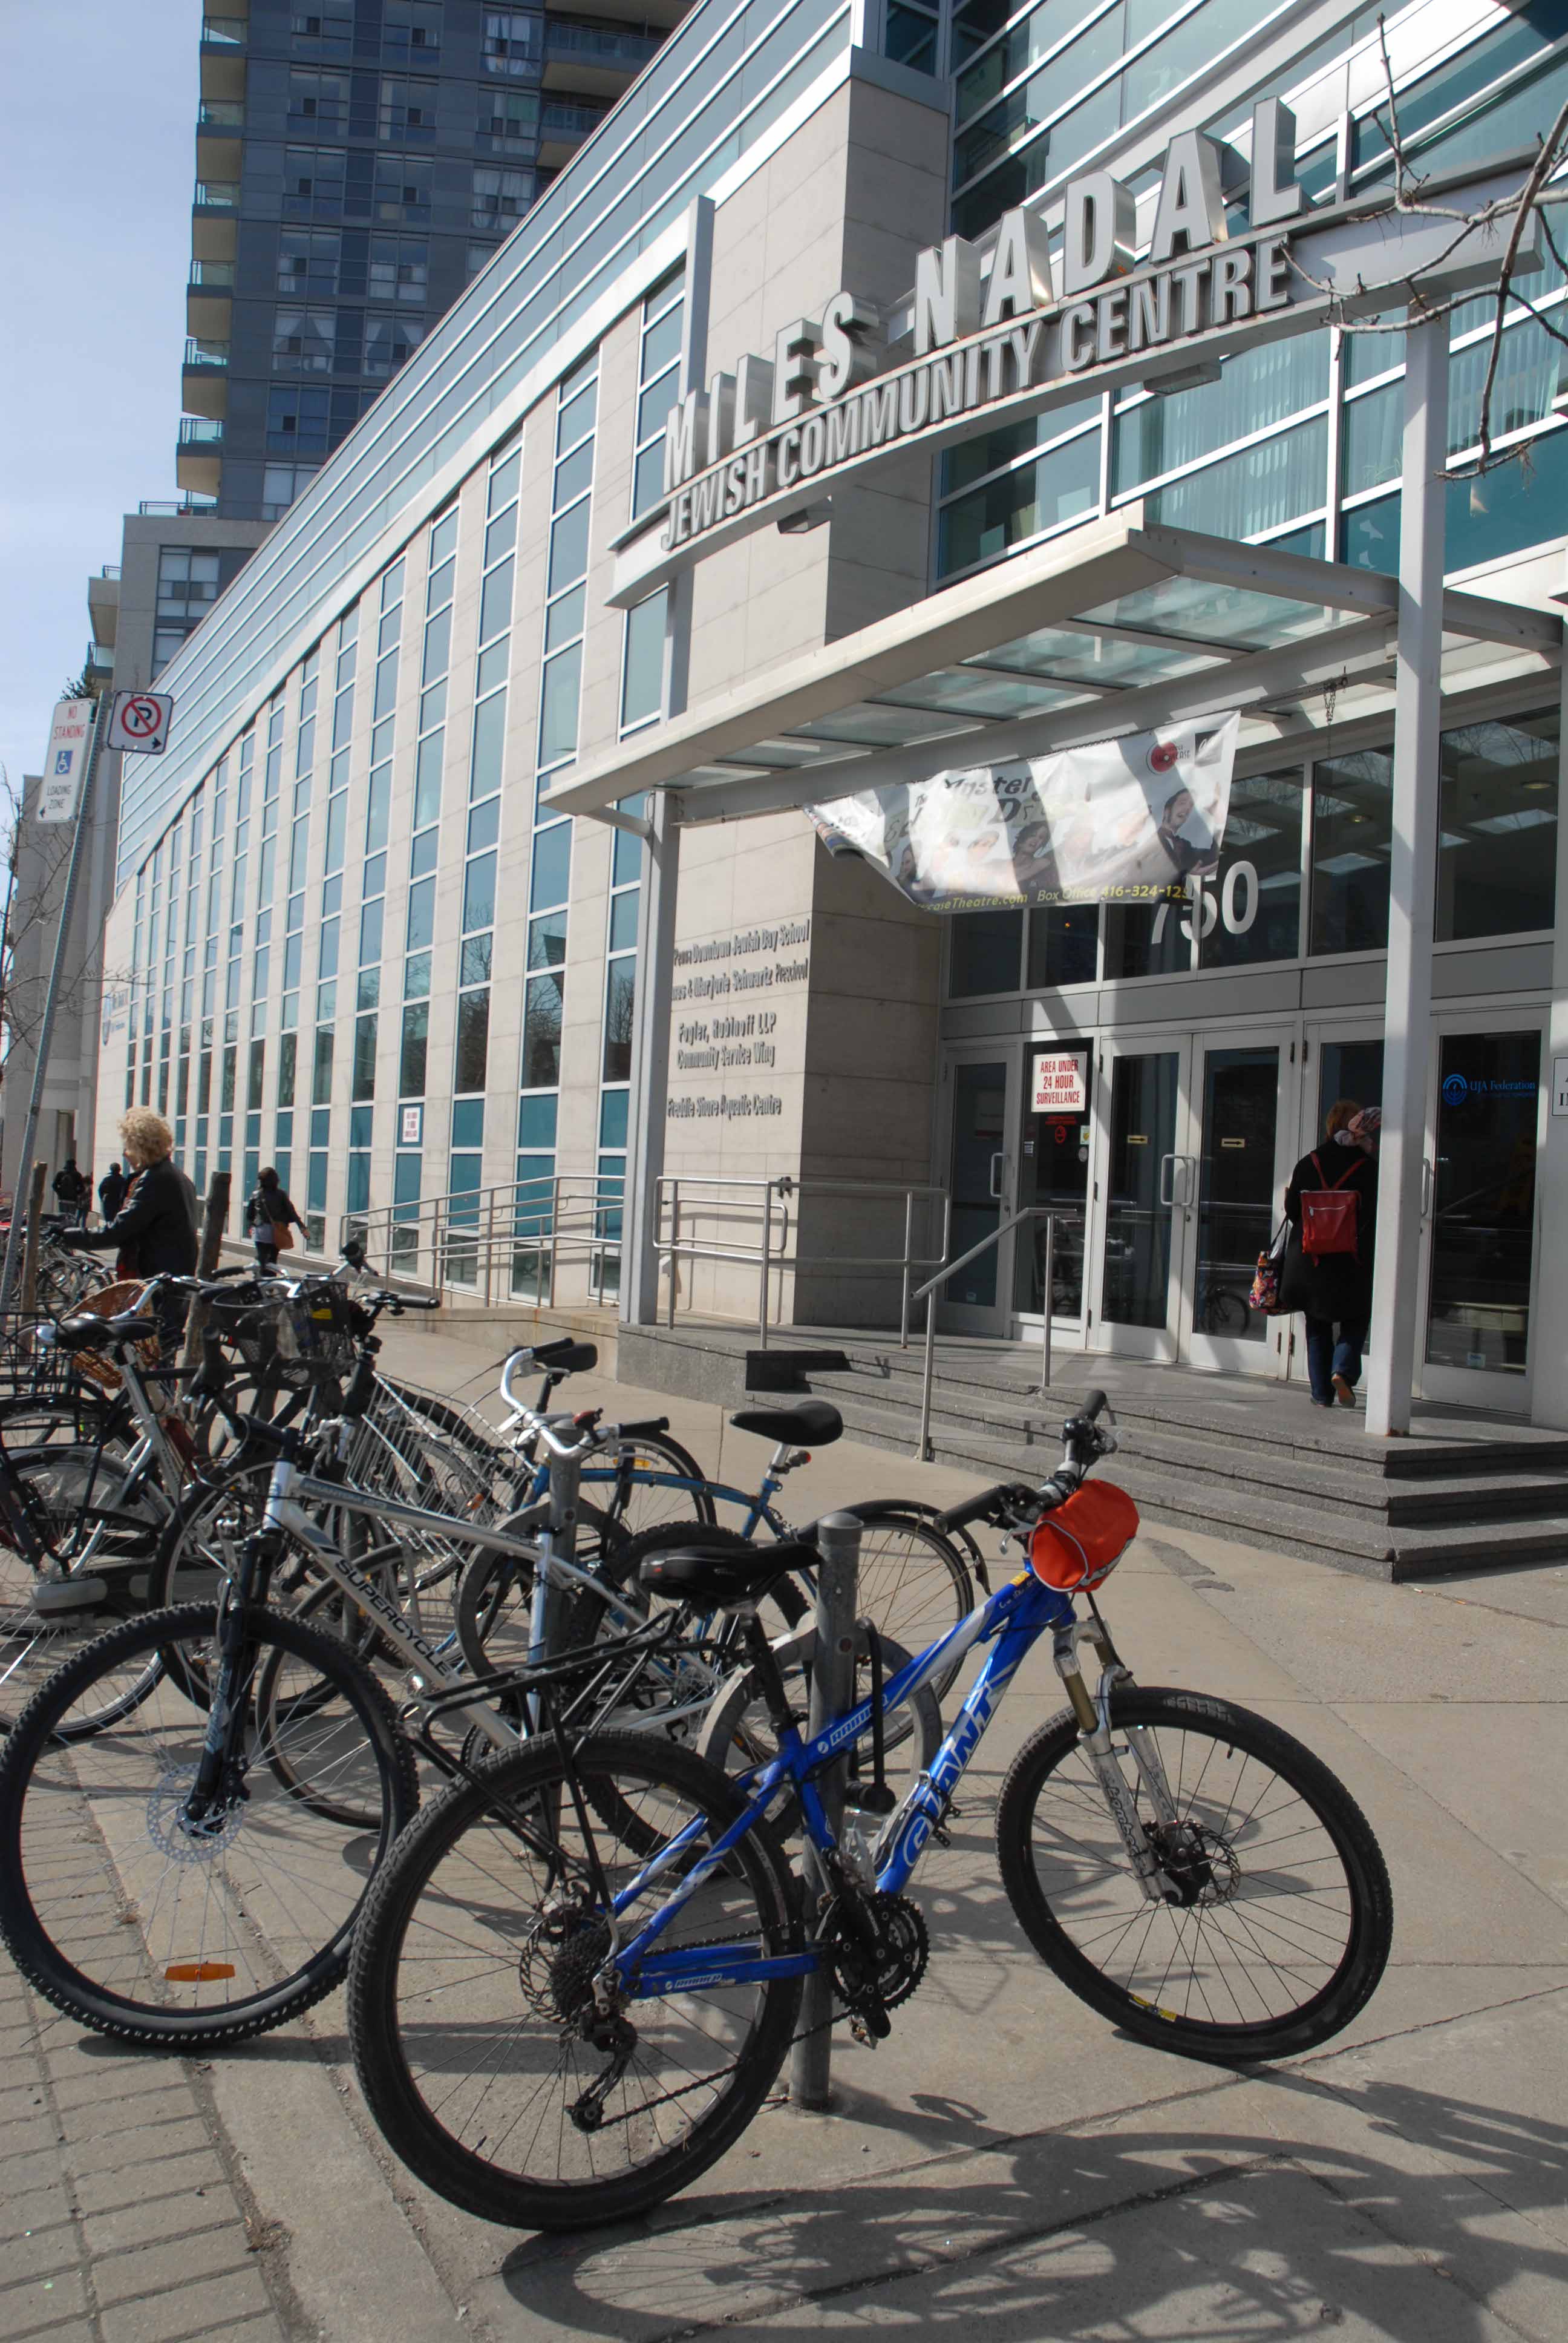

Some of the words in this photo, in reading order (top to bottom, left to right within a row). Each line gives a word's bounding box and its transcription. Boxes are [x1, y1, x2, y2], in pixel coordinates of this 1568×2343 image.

[663, 291, 855, 493] MILES
[914, 96, 1302, 357] NADAL
[661, 441, 768, 551] JEWISH
[776, 319, 1042, 487] COMMUNITY
[1059, 232, 1289, 372] CENTRE
[68, 706, 77, 719] NO
[54, 724, 85, 739] STANDING
[1037, 890, 1059, 902] Box
[693, 940, 731, 963] Downtown
[733, 930, 761, 956] Jewish
[762, 929, 779, 952] Day
[779, 919, 810, 947] School
[732, 966, 773, 992] Schwartz
[775, 957, 809, 983] Preschool
[713, 1014, 755, 1040] Rubinoff
[759, 1012, 777, 1035] LLP
[678, 1046, 720, 1070] Community
[720, 1043, 751, 1067] Service
[753, 1041, 776, 1068] Wing
[1040, 1061, 1056, 1073] AREA
[1058, 1059, 1079, 1072] UNDER
[1043, 1076, 1053, 1090] 24
[1055, 1075, 1074, 1089] HOUR
[1470, 1080, 1488, 1094] UJA
[1490, 1080, 1535, 1090] Federation
[720, 1094, 752, 1121] Aquatic
[753, 1094, 782, 1116] Centre
[1036, 1090, 1080, 1105] SURVEILLANCE
[335, 1558, 452, 1676] SUPERCYCLE
[903, 1680, 998, 1867] GIANT
